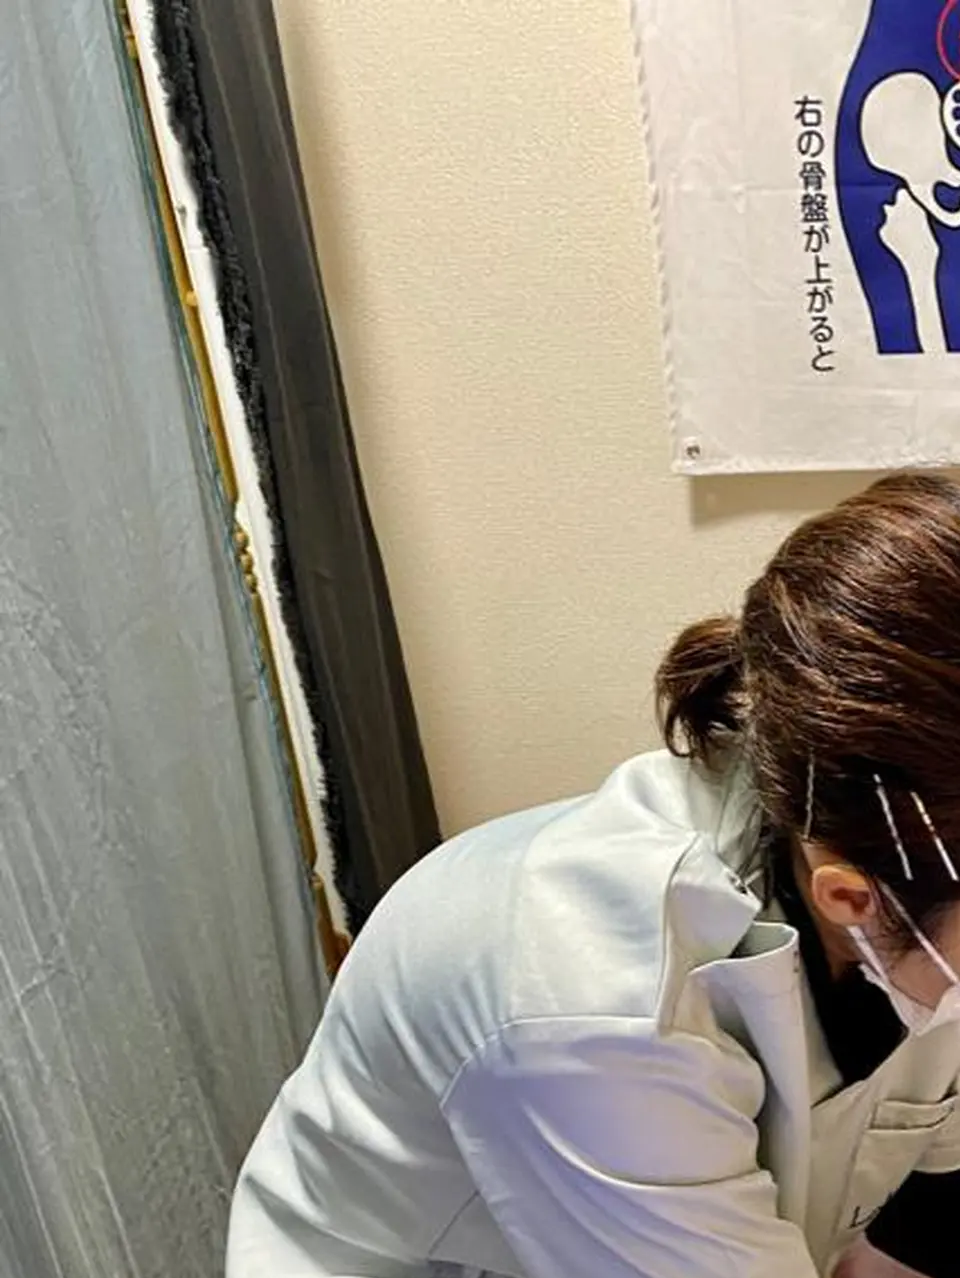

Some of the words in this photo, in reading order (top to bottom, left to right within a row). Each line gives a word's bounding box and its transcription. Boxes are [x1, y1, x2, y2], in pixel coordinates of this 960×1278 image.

[793, 95, 835, 374] 右の骨盤が上がると
